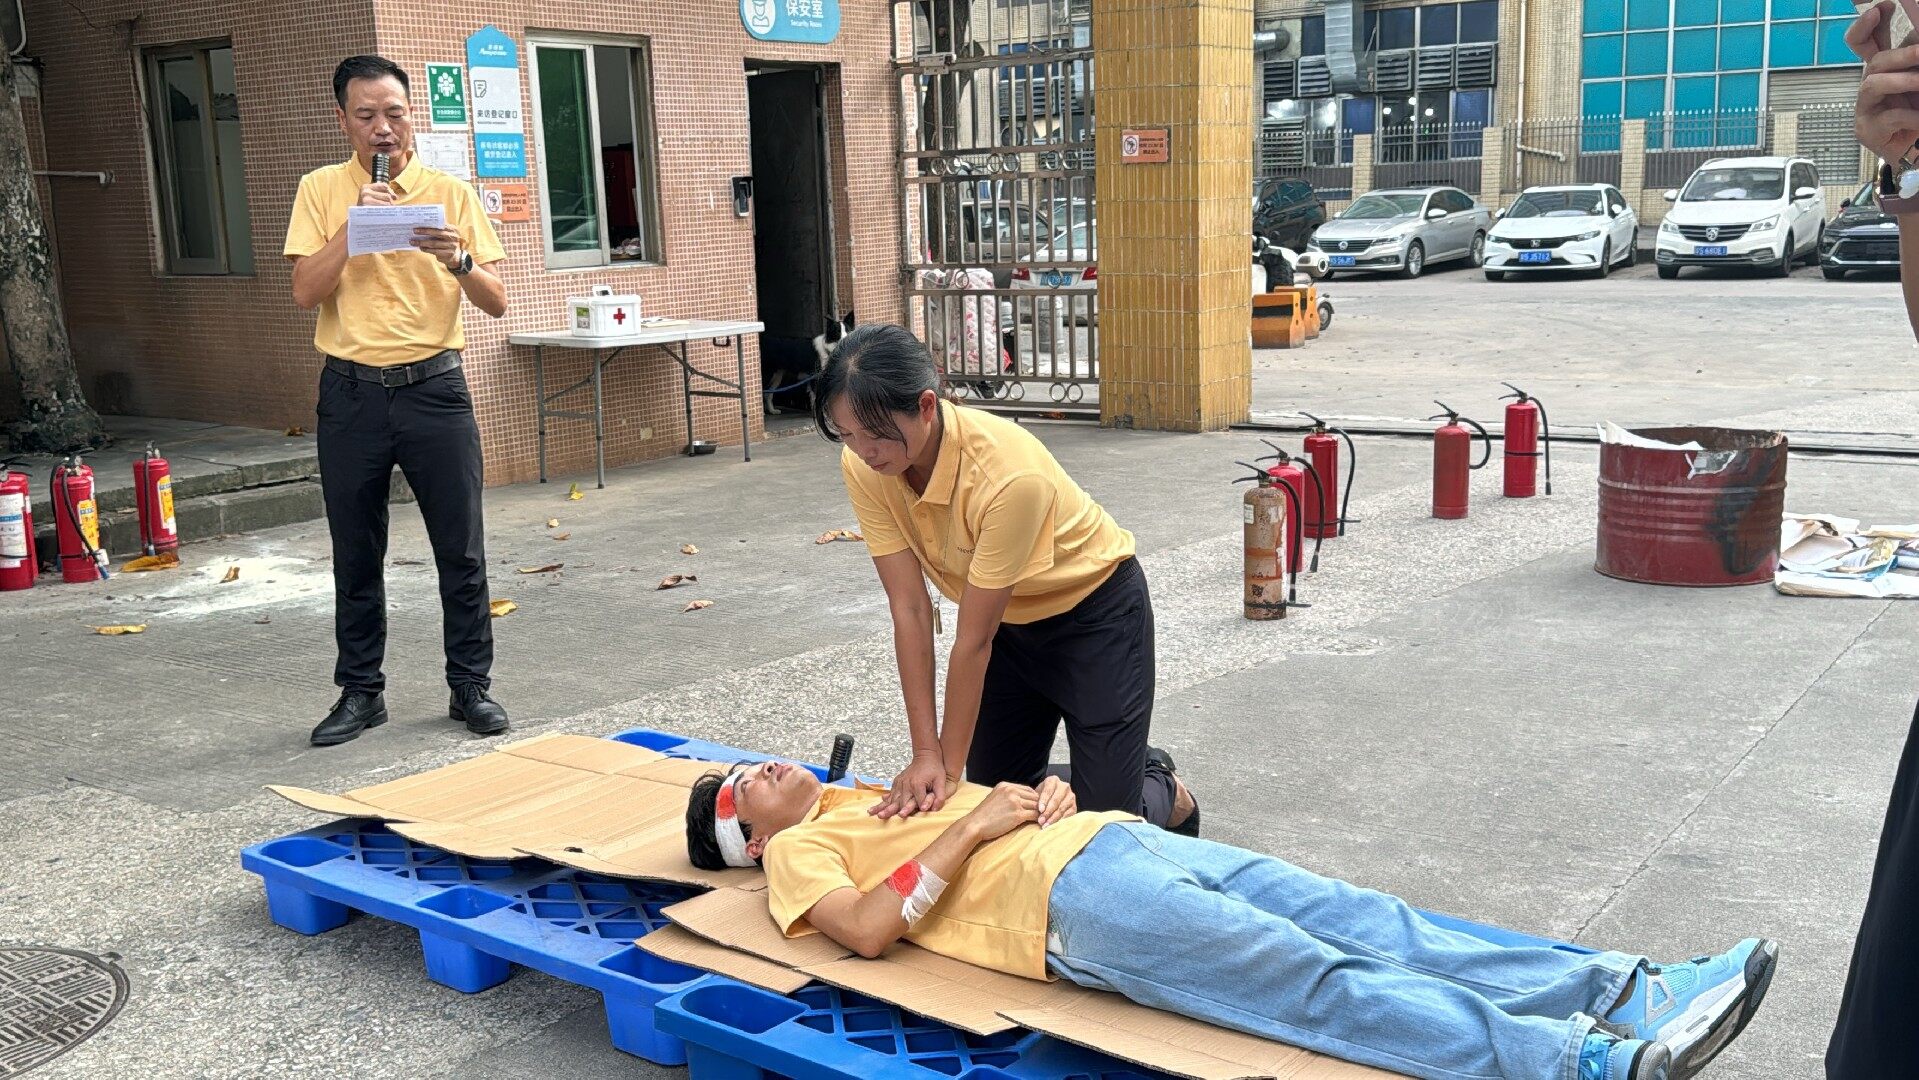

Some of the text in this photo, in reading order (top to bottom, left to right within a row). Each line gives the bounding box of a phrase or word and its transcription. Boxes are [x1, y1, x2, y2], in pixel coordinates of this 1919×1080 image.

[786, 0, 823, 18] 保安室
[477, 109, 518, 119] 来访登记窗口
